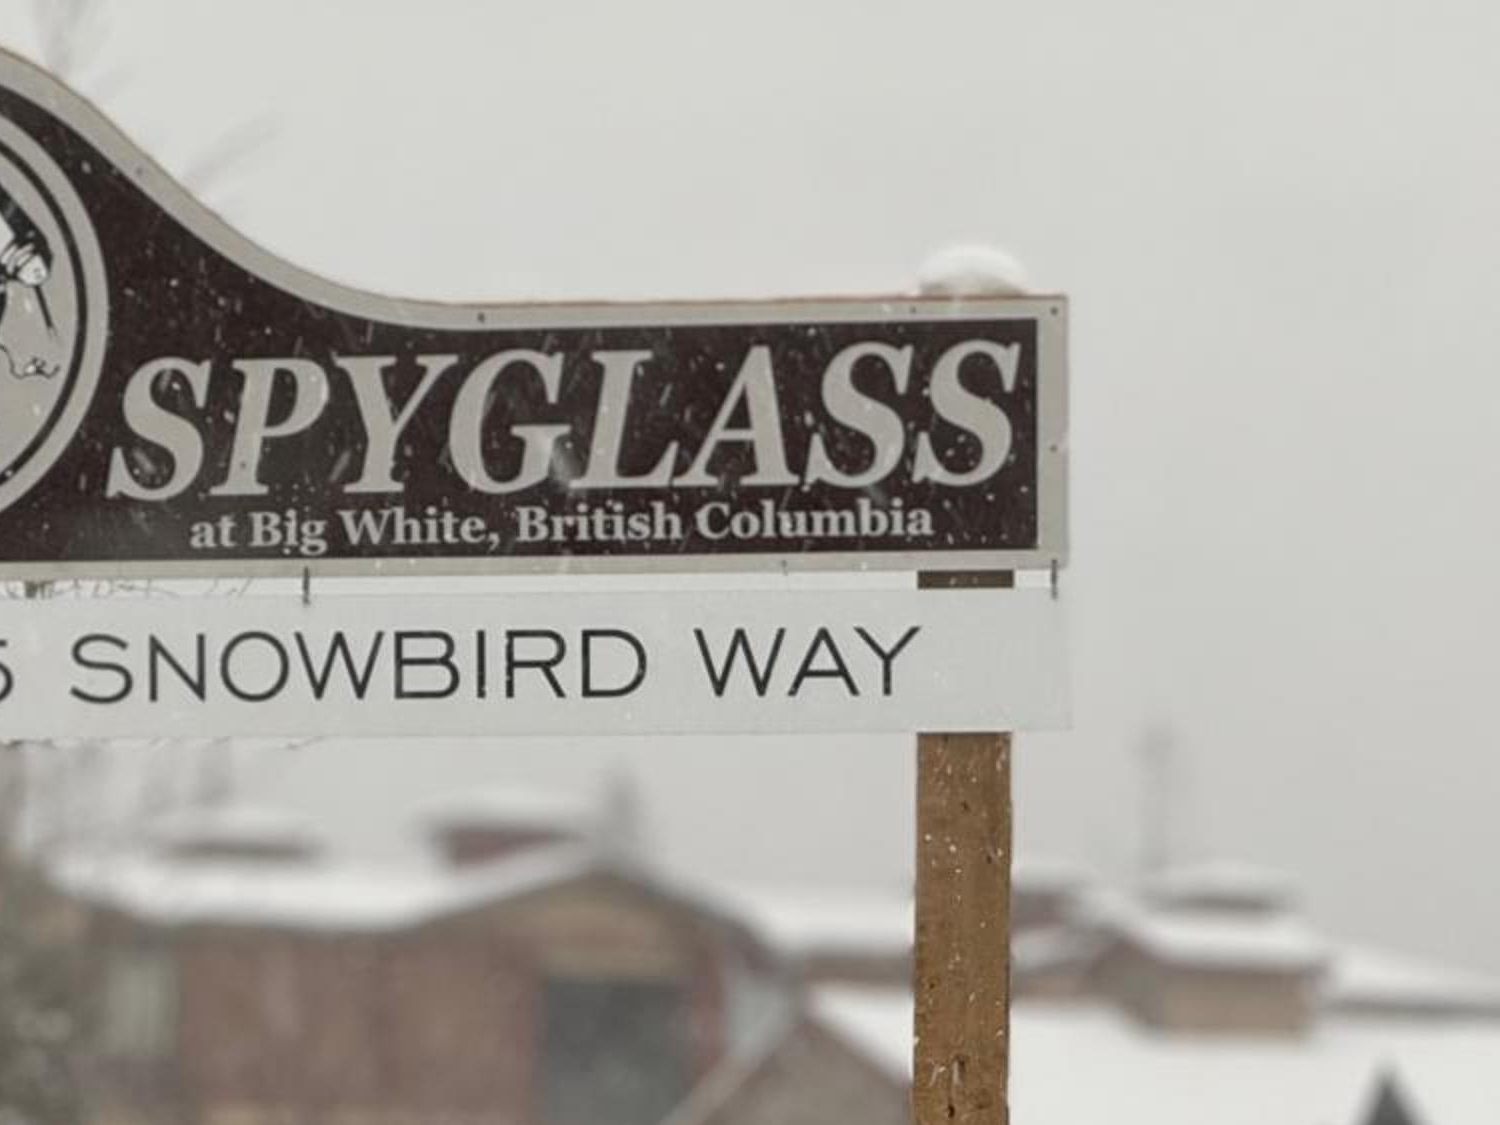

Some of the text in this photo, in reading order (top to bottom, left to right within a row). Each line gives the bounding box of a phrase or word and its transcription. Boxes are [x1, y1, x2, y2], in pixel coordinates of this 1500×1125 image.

[105, 339, 1024, 502] SPYGLASS
[189, 496, 934, 556] at Big White, British Columbia
[69, 626, 649, 705] SNOWBIRD
[693, 624, 921, 699] WAY
